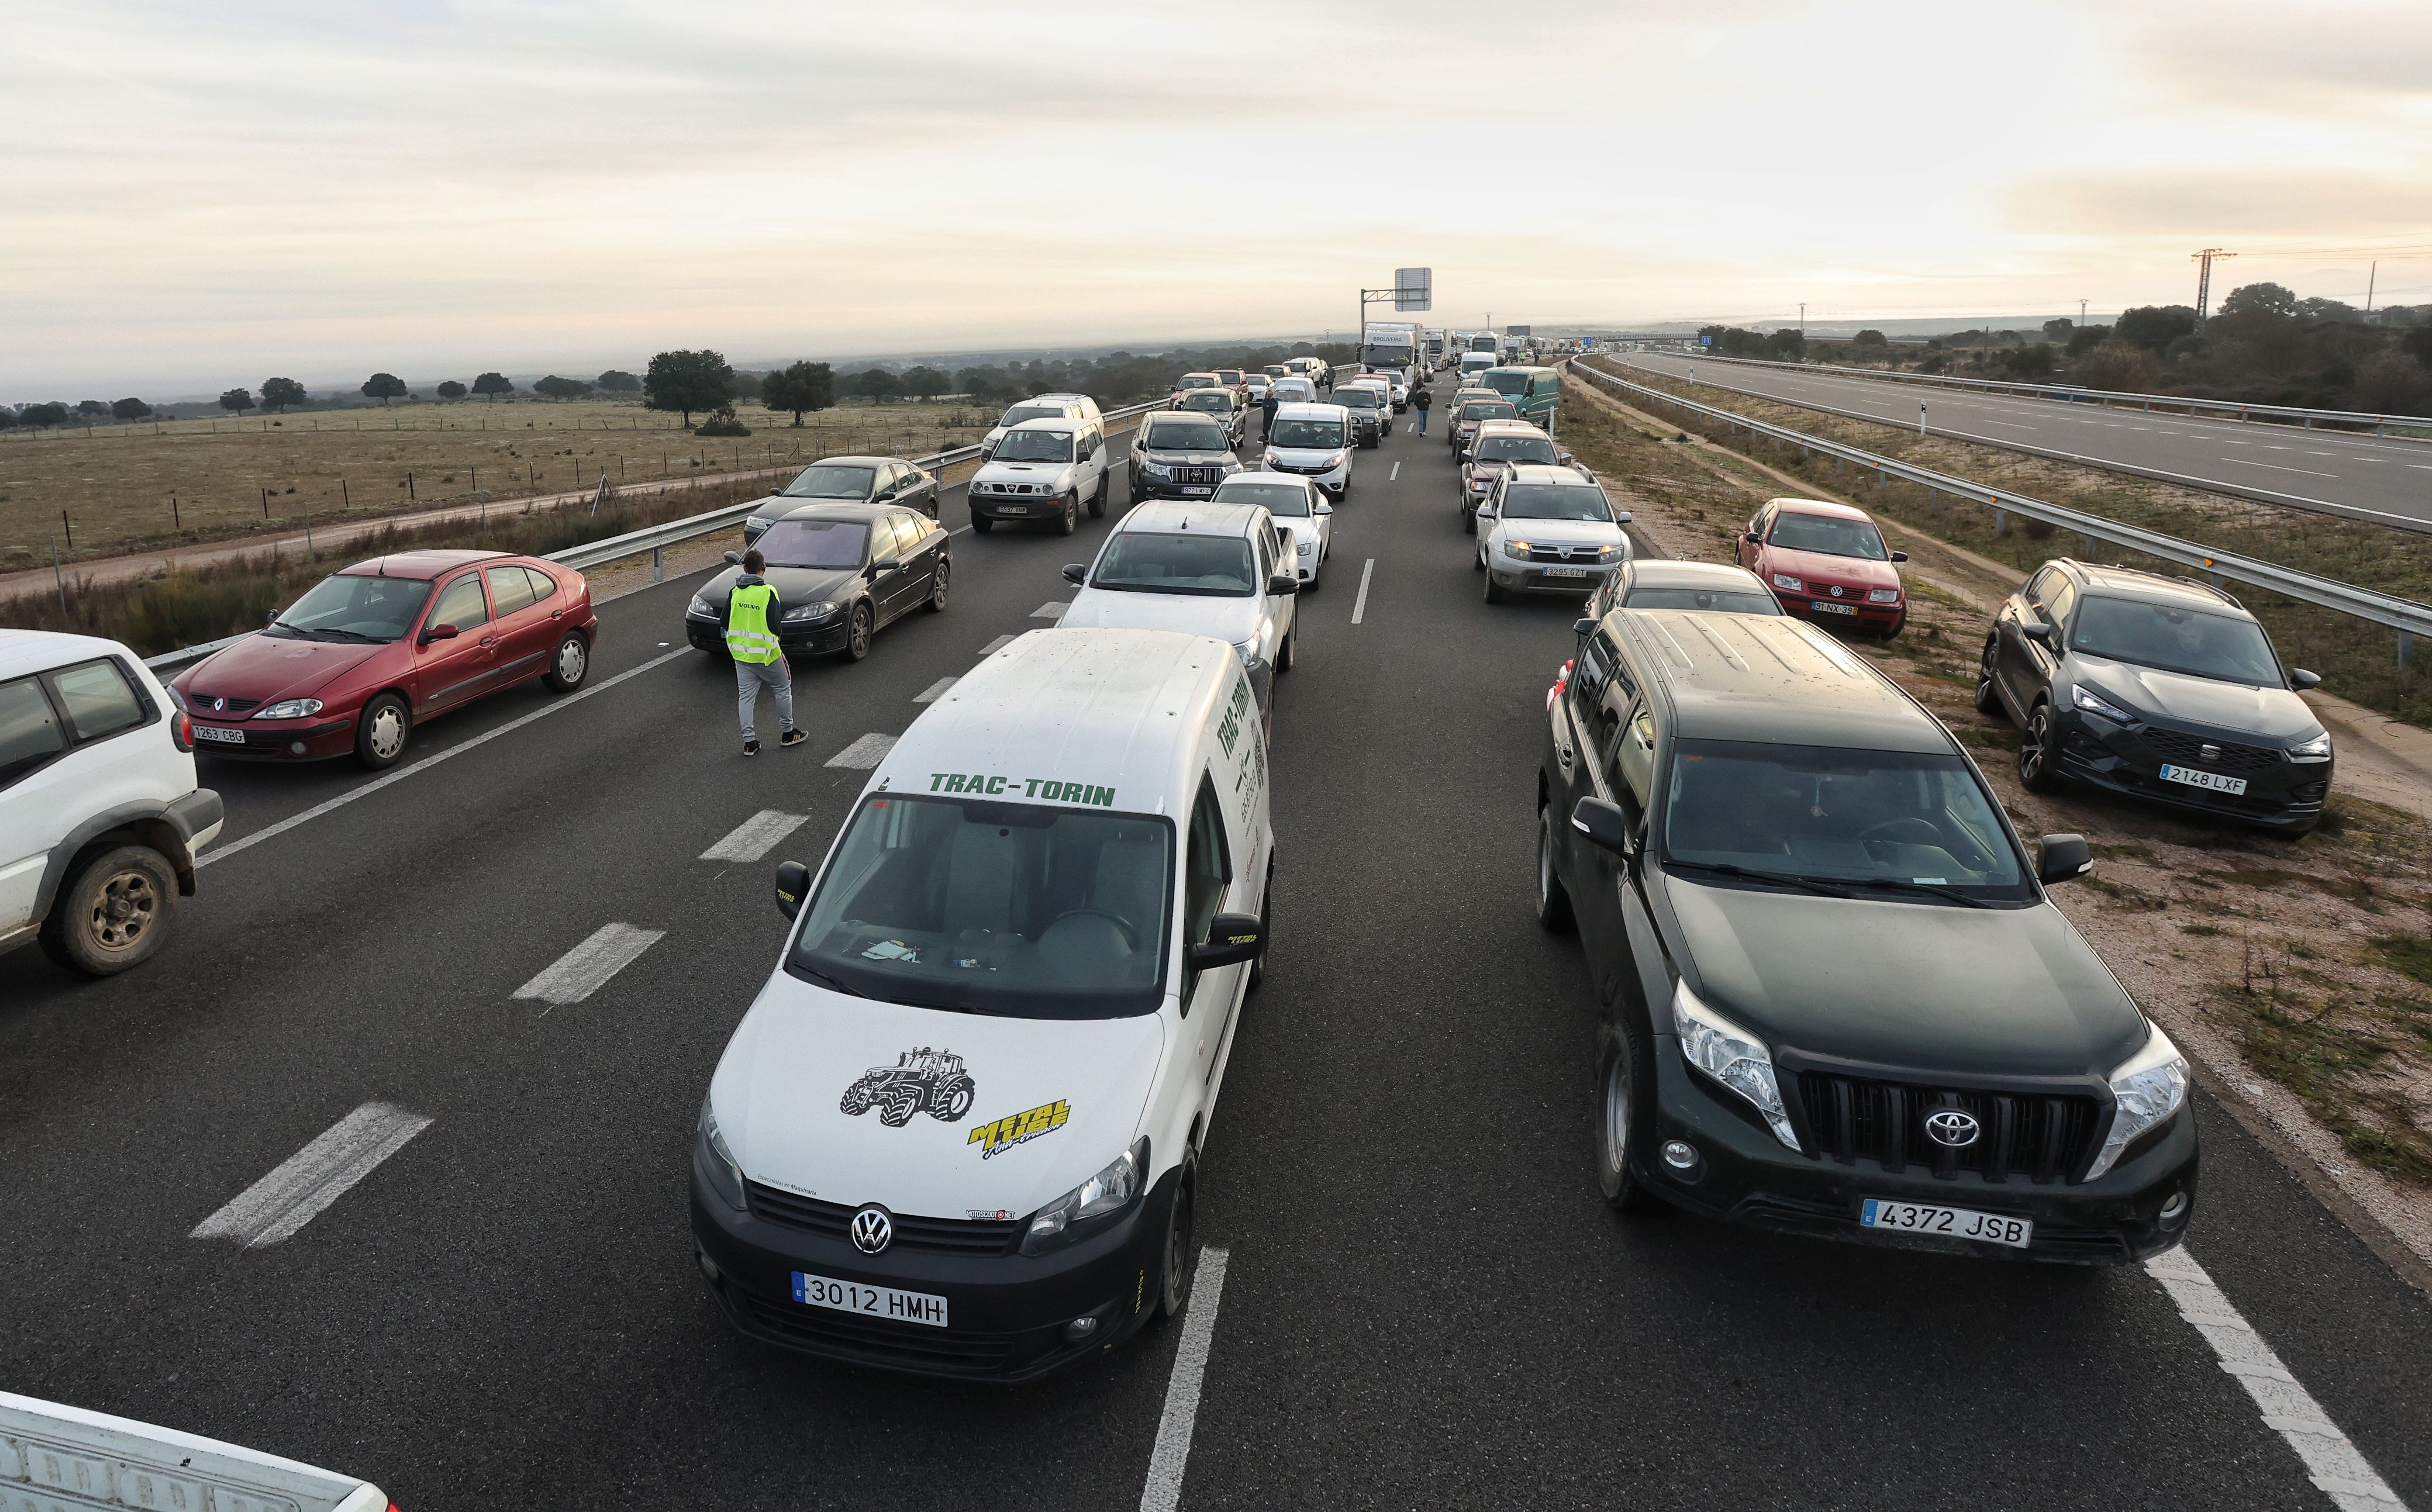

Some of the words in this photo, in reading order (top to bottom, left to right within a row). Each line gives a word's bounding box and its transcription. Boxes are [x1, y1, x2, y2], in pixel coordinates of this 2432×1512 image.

[196, 727, 218, 739] 1263
[223, 730, 243, 742] CBG
[930, 772, 1116, 807] TRAC-TORIN
[2170, 768, 2209, 786] 2148
[2213, 776, 2243, 792] LXF
[967, 1099, 1071, 1145] METAL
[757, 1173, 784, 1186] Especialistas
[790, 1184, 817, 1196] Maquinaria
[1881, 1204, 1955, 1232] 4372
[1965, 1215, 2024, 1243] JSB
[810, 1280, 878, 1313] 3012
[888, 1292, 941, 1322] HMH
